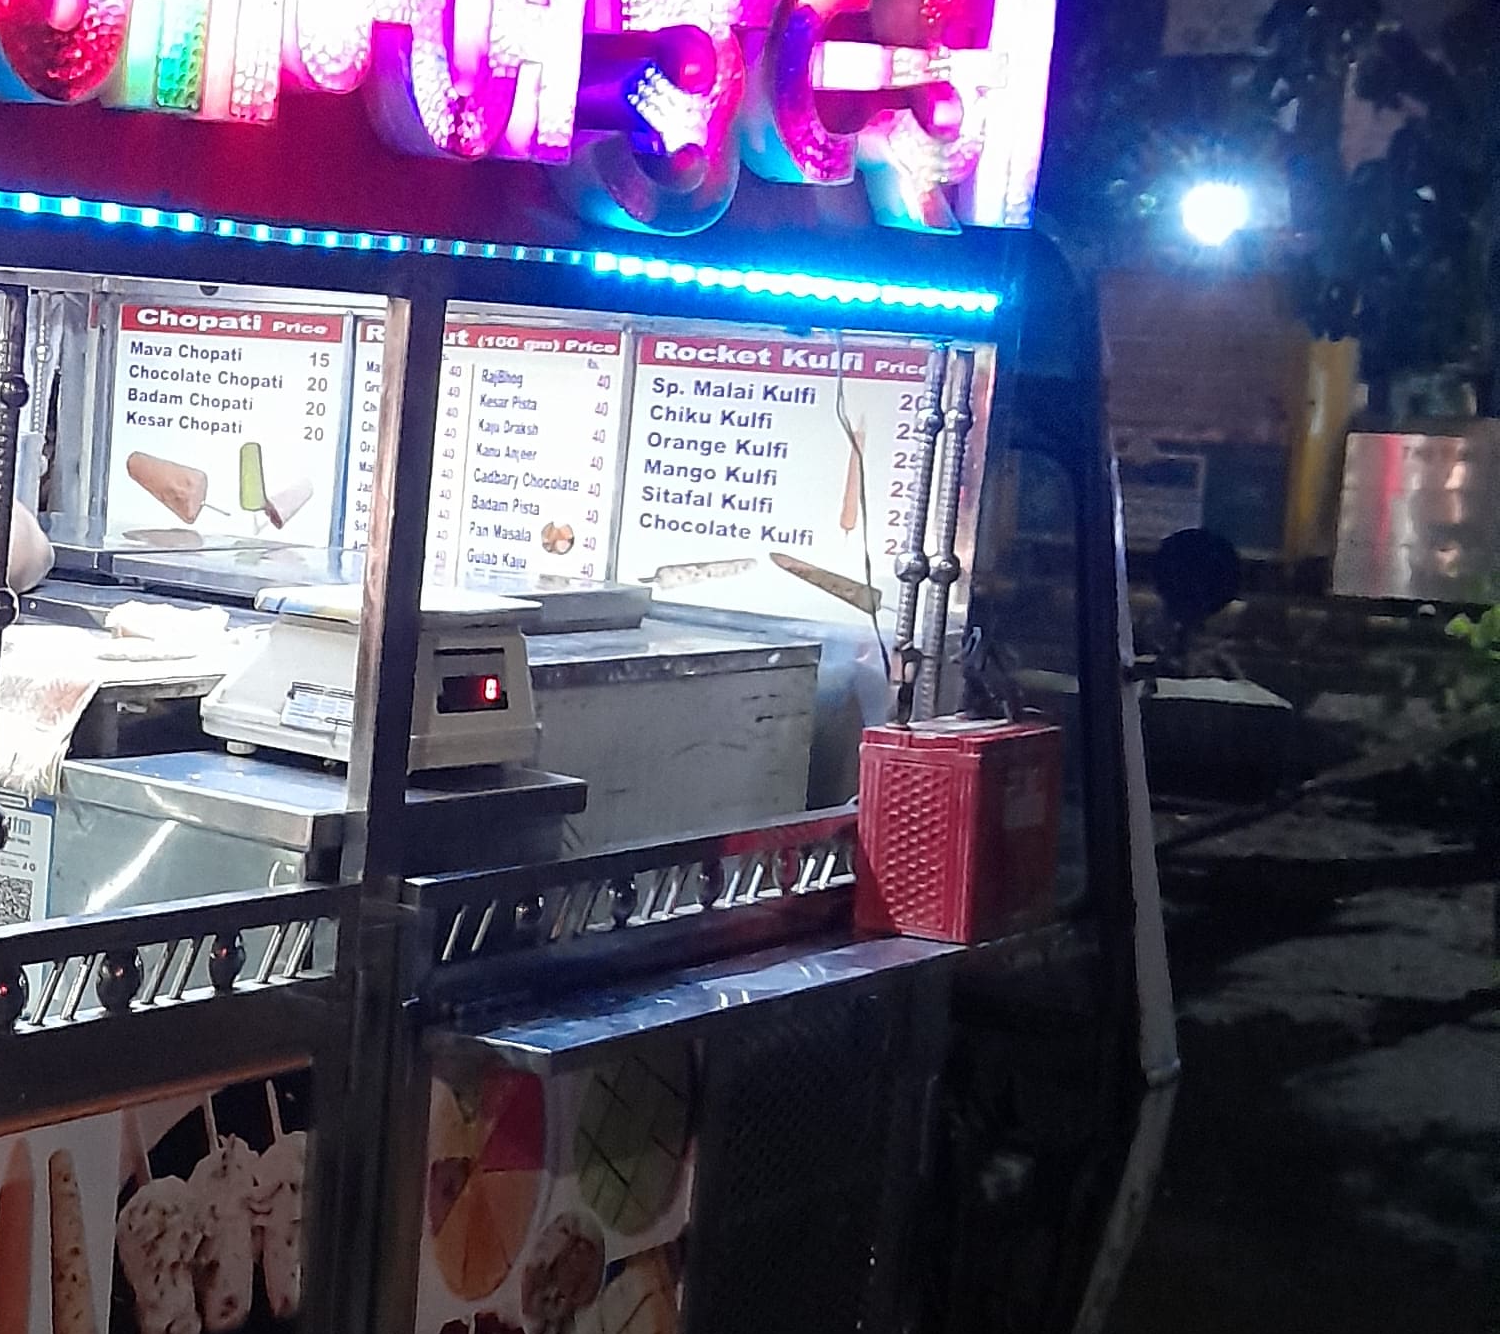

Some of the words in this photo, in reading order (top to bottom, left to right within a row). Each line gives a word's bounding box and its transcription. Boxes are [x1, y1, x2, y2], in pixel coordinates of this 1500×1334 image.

[137, 309, 262, 331] Chopati
[272, 321, 329, 335] Price
[130, 341, 172, 357] Mava
[179, 345, 242, 363] Chopati
[309, 352, 330, 368] 15
[477, 335, 518, 347] (100
[565, 340, 617, 353] Price
[654, 341, 771, 366] Rocket
[782, 348, 864, 371] Kulfi
[129, 365, 211, 384] Chocolate
[218, 371, 283, 390] Chopati
[307, 377, 328, 392] 20
[597, 375, 610, 389] 40
[652, 377, 684, 397] Sp.
[694, 380, 754, 399] Malai
[762, 385, 816, 405] Kulfi
[128, 388, 182, 405] Badam
[190, 393, 253, 411] Chopati
[306, 402, 326, 416] 20
[480, 394, 508, 408] Kesar
[512, 396, 536, 410] Pista
[595, 402, 608, 416] 40
[126, 411, 173, 428] Kesar
[179, 416, 242, 435] Chopati
[303, 426, 323, 441] 20
[650, 405, 711, 425] Chiku
[720, 410, 772, 429] Kulfi
[593, 430, 605, 443] 40
[648, 432, 726, 456] Orange
[736, 439, 788, 459] Kulfi
[590, 456, 603, 470] 40
[644, 459, 716, 483] Mango
[725, 467, 777, 486] Kulfi
[523, 472, 579, 491] Chocolate
[588, 483, 600, 497] 40
[471, 495, 508, 511] Badam
[512, 498, 539, 515] Pista
[586, 510, 598, 524] 40
[642, 486, 712, 507] Sitafal
[721, 494, 772, 513] Kulfi
[470, 522, 488, 536] Pan
[494, 525, 531, 542] Masala
[583, 537, 596, 550] 40
[639, 513, 751, 540] Chocolate
[761, 526, 813, 546] Kulfi
[581, 563, 593, 578] 40
